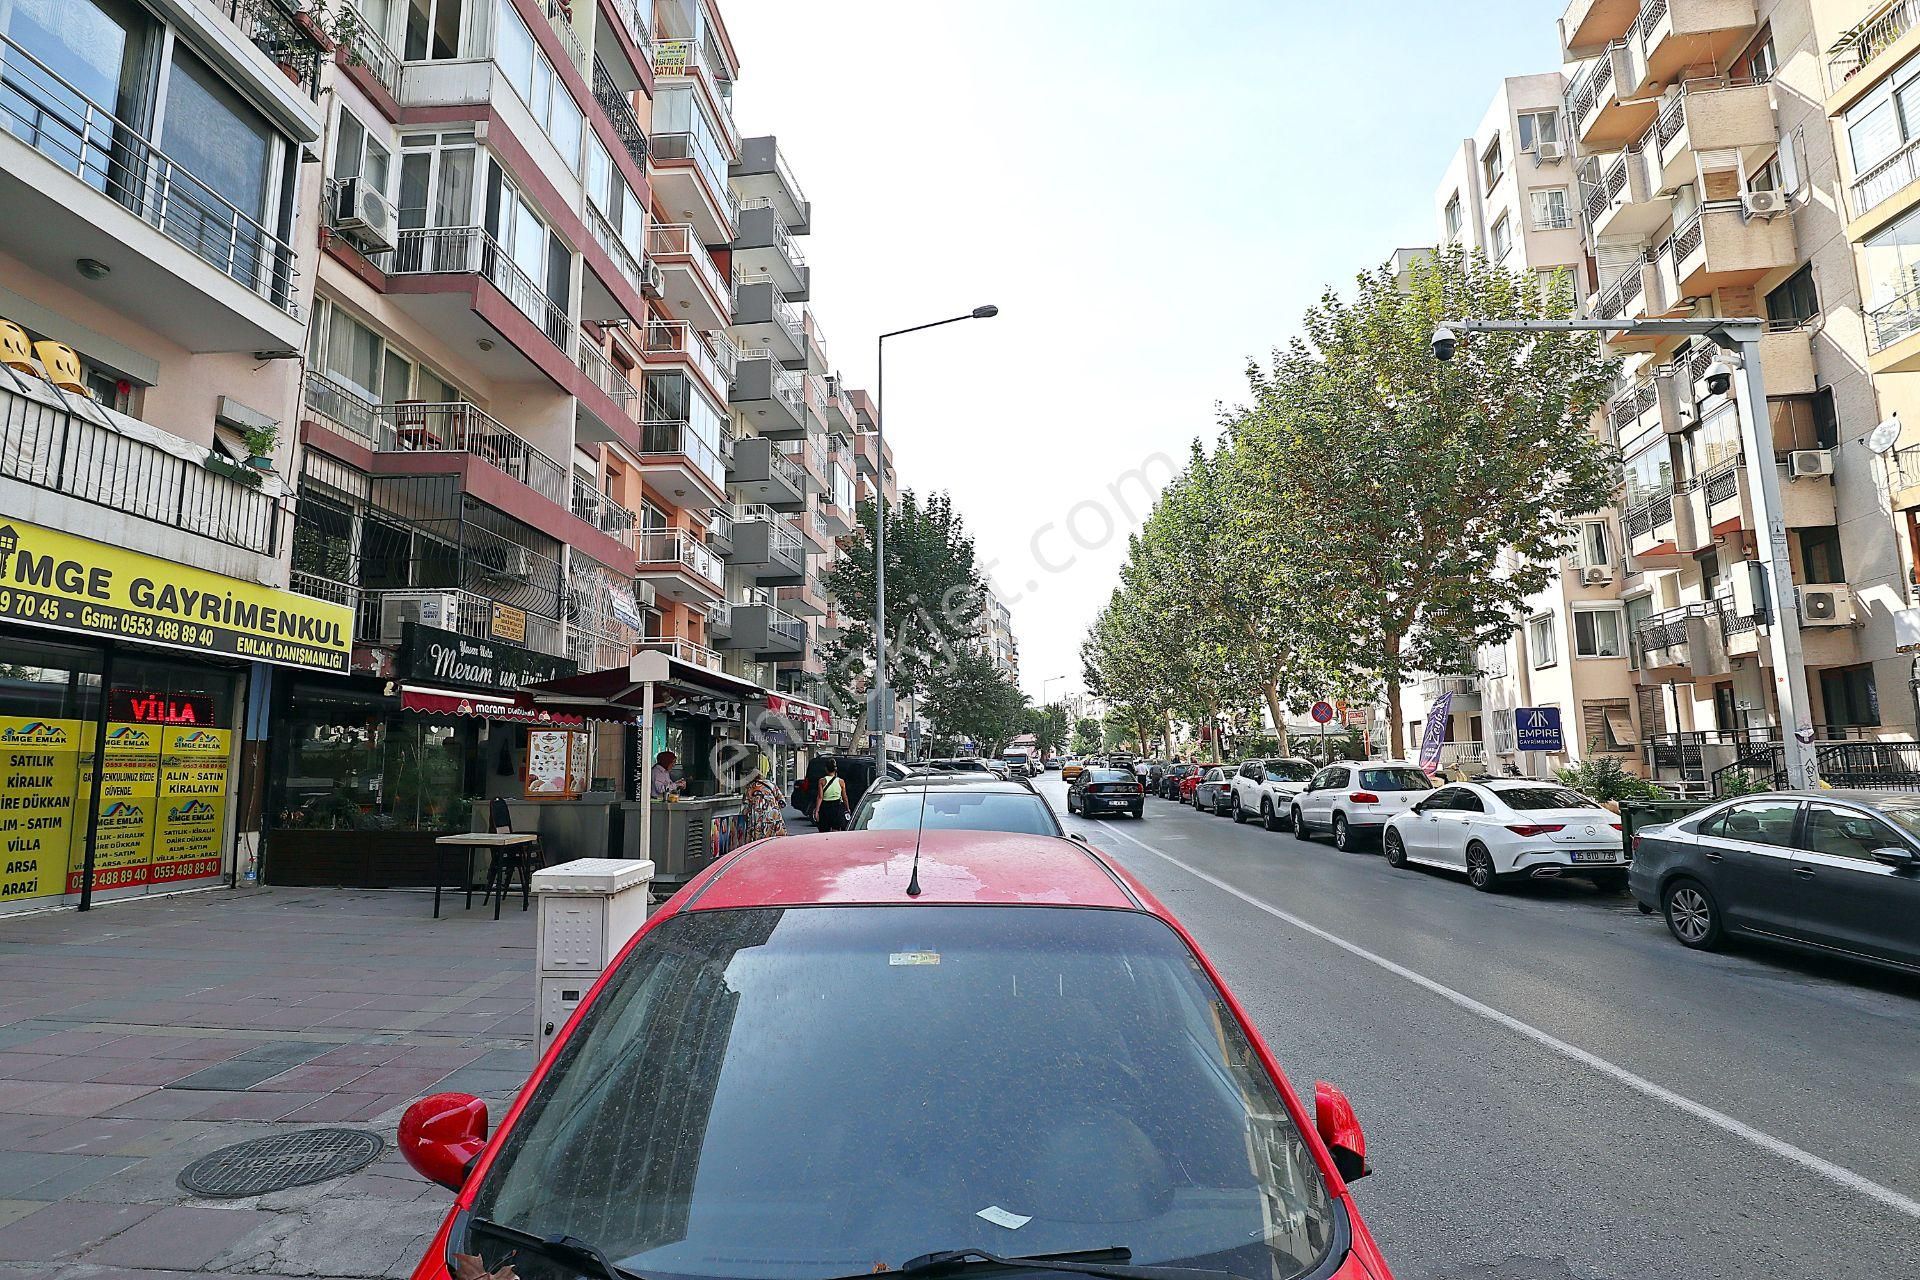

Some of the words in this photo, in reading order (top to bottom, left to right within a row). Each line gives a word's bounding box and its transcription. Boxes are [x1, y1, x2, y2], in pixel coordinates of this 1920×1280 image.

[654, 66, 684, 76] SATILIK
[129, 577, 345, 647] GAYRİMENKUL
[16, 593, 36, 617] 70
[39, 598, 59, 621] 45
[81, 605, 118, 630] Gsm:
[120, 613, 153, 637] 0553
[156, 618, 179, 640] 488
[182, 624, 197, 644] 89
[199, 627, 214, 647] 40
[236, 636, 274, 658] EMLAK
[275, 641, 342, 669] DANIŞMANLIĞI
[430, 643, 492, 684] Meram
[130, 694, 195, 723] VİLLA
[475, 703, 506, 715] meram
[35, 736, 67, 744] EMLAK
[1518, 728, 1559, 738] EMPIRE
[10, 754, 54, 767] SATILIK
[7, 772, 54, 788] KİRALIK
[166, 772, 189, 781] ALIN
[197, 772, 224, 781] SATIN
[169, 783, 219, 794] KİRALAYIN
[22, 794, 70, 809] DÜKKAN
[27, 817, 62, 830] SATIM
[116, 817, 144, 825] EMLAK
[7, 836, 41, 852] VİLLA
[6, 859, 38, 874] ARSA
[154, 865, 176, 879] 0553
[177, 863, 194, 876] 488
[194, 862, 205, 874] 89
[206, 861, 217, 872] 40
[99, 871, 118, 885] 488
[120, 870, 132, 883] 89
[134, 868, 147, 880] 40
[1, 877, 38, 896] ARAZİ
